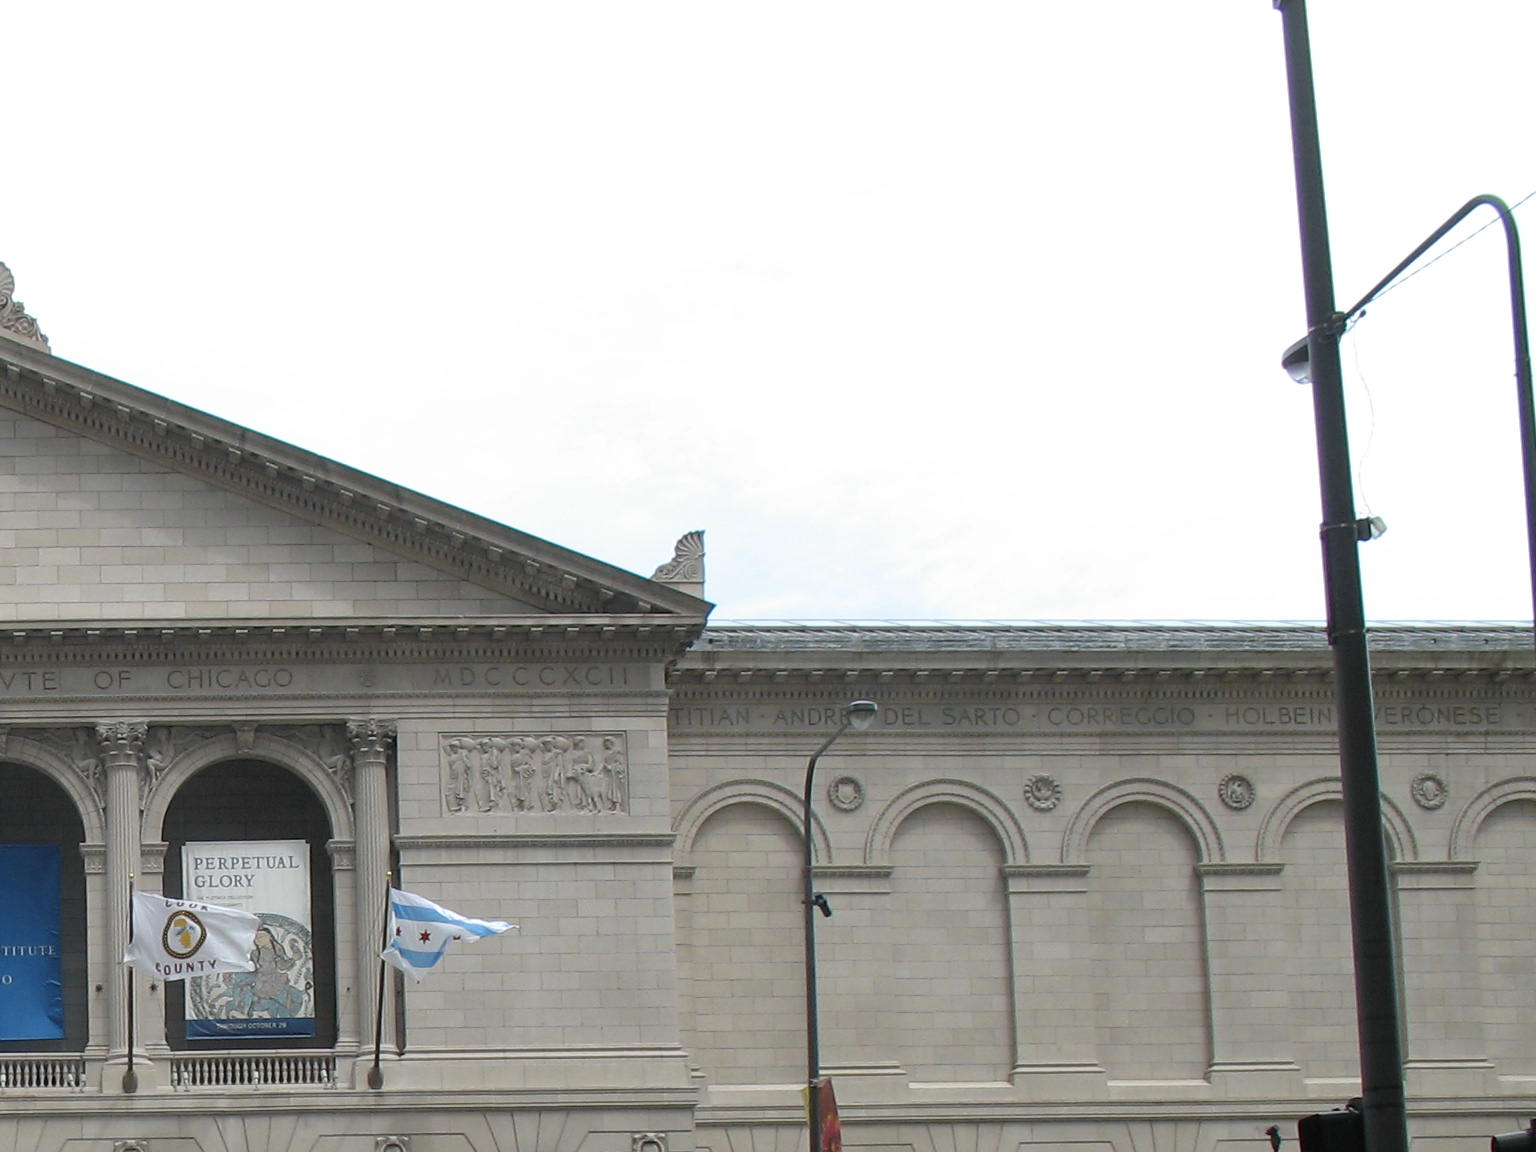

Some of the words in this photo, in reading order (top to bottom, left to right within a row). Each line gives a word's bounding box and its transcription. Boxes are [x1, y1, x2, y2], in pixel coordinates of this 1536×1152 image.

[93, 670, 132, 690] OF
[166, 668, 294, 689] CHICAGO
[669, 706, 751, 727] TITIAN
[773, 706, 849, 727] ANDRE
[883, 706, 932, 726] DEL
[941, 706, 1021, 726] SARTO
[1047, 706, 1196, 726] CORREGGIO
[1225, 706, 1332, 725] HOLBEIN
[193, 855, 300, 871] PERPETUAL
[194, 874, 256, 888] GLORY
[155, 960, 218, 976] COUNTY
